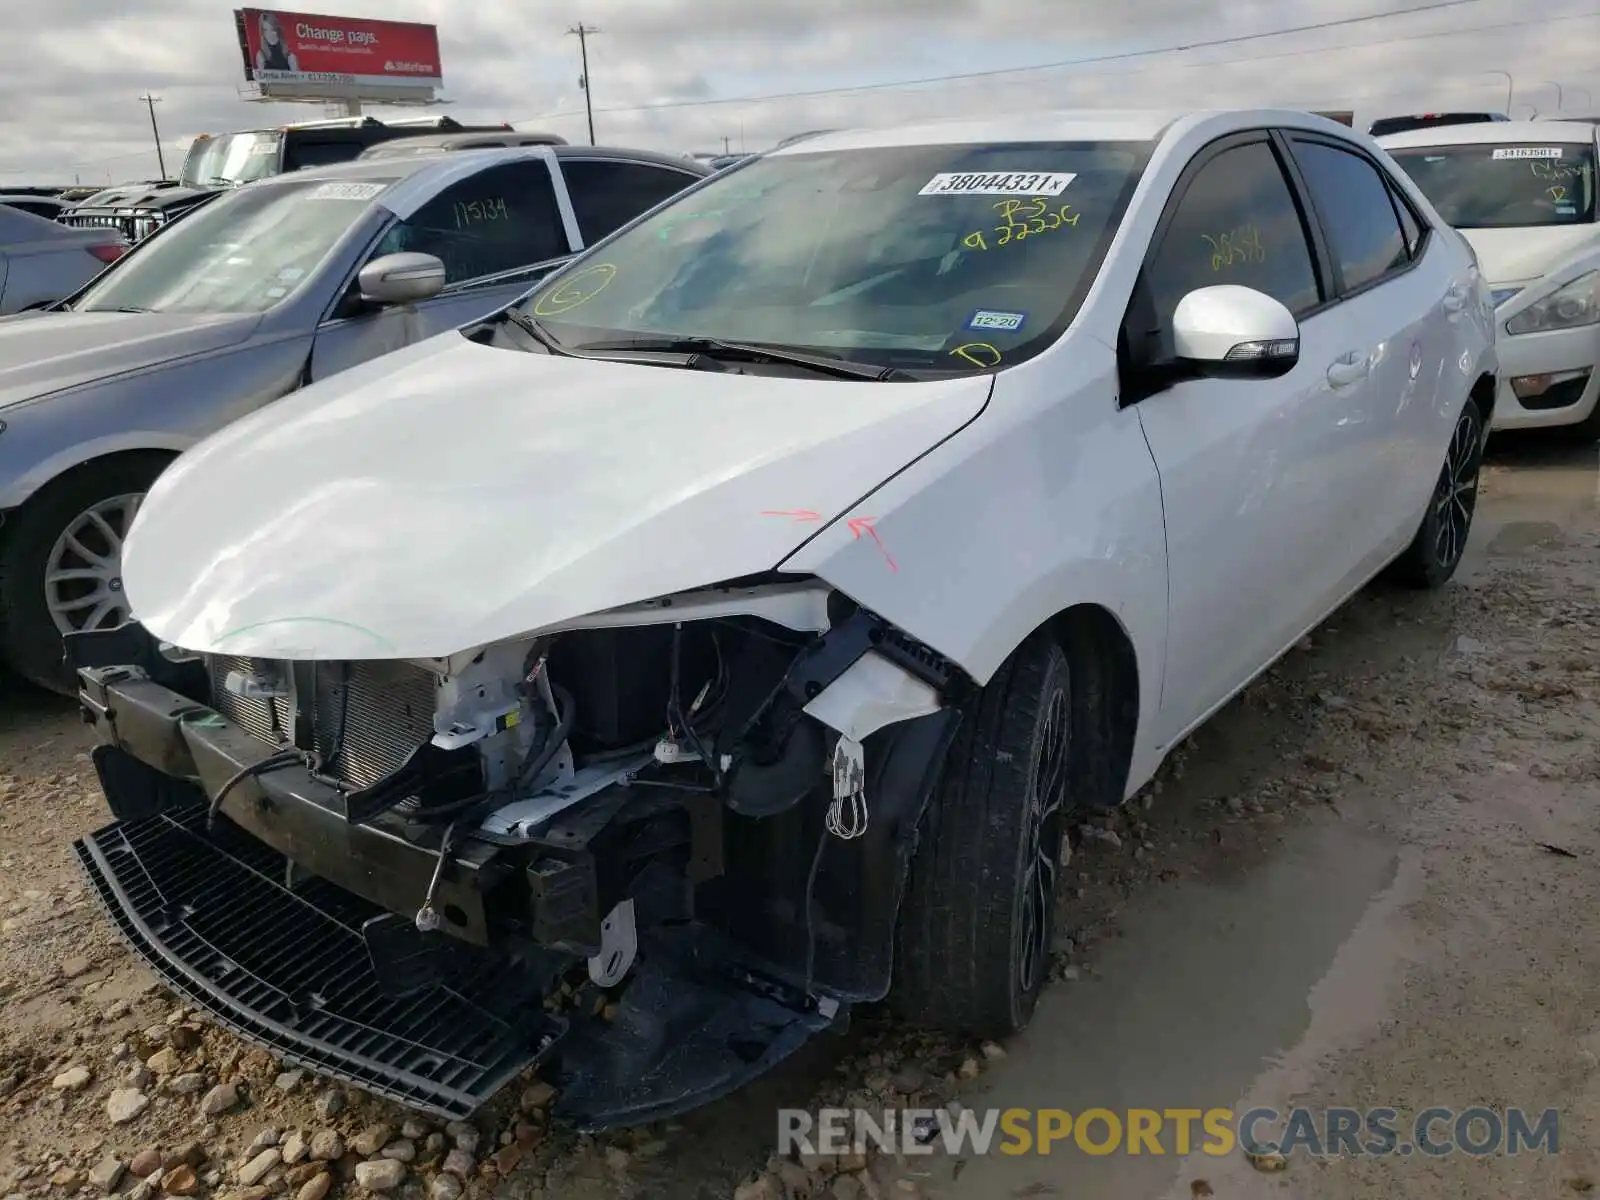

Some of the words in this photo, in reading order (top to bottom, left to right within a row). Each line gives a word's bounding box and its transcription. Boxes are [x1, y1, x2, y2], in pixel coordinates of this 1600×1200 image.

[295, 22, 345, 43] Change
[347, 30, 380, 45] pays.
[940, 174, 1053, 191] 38044331
